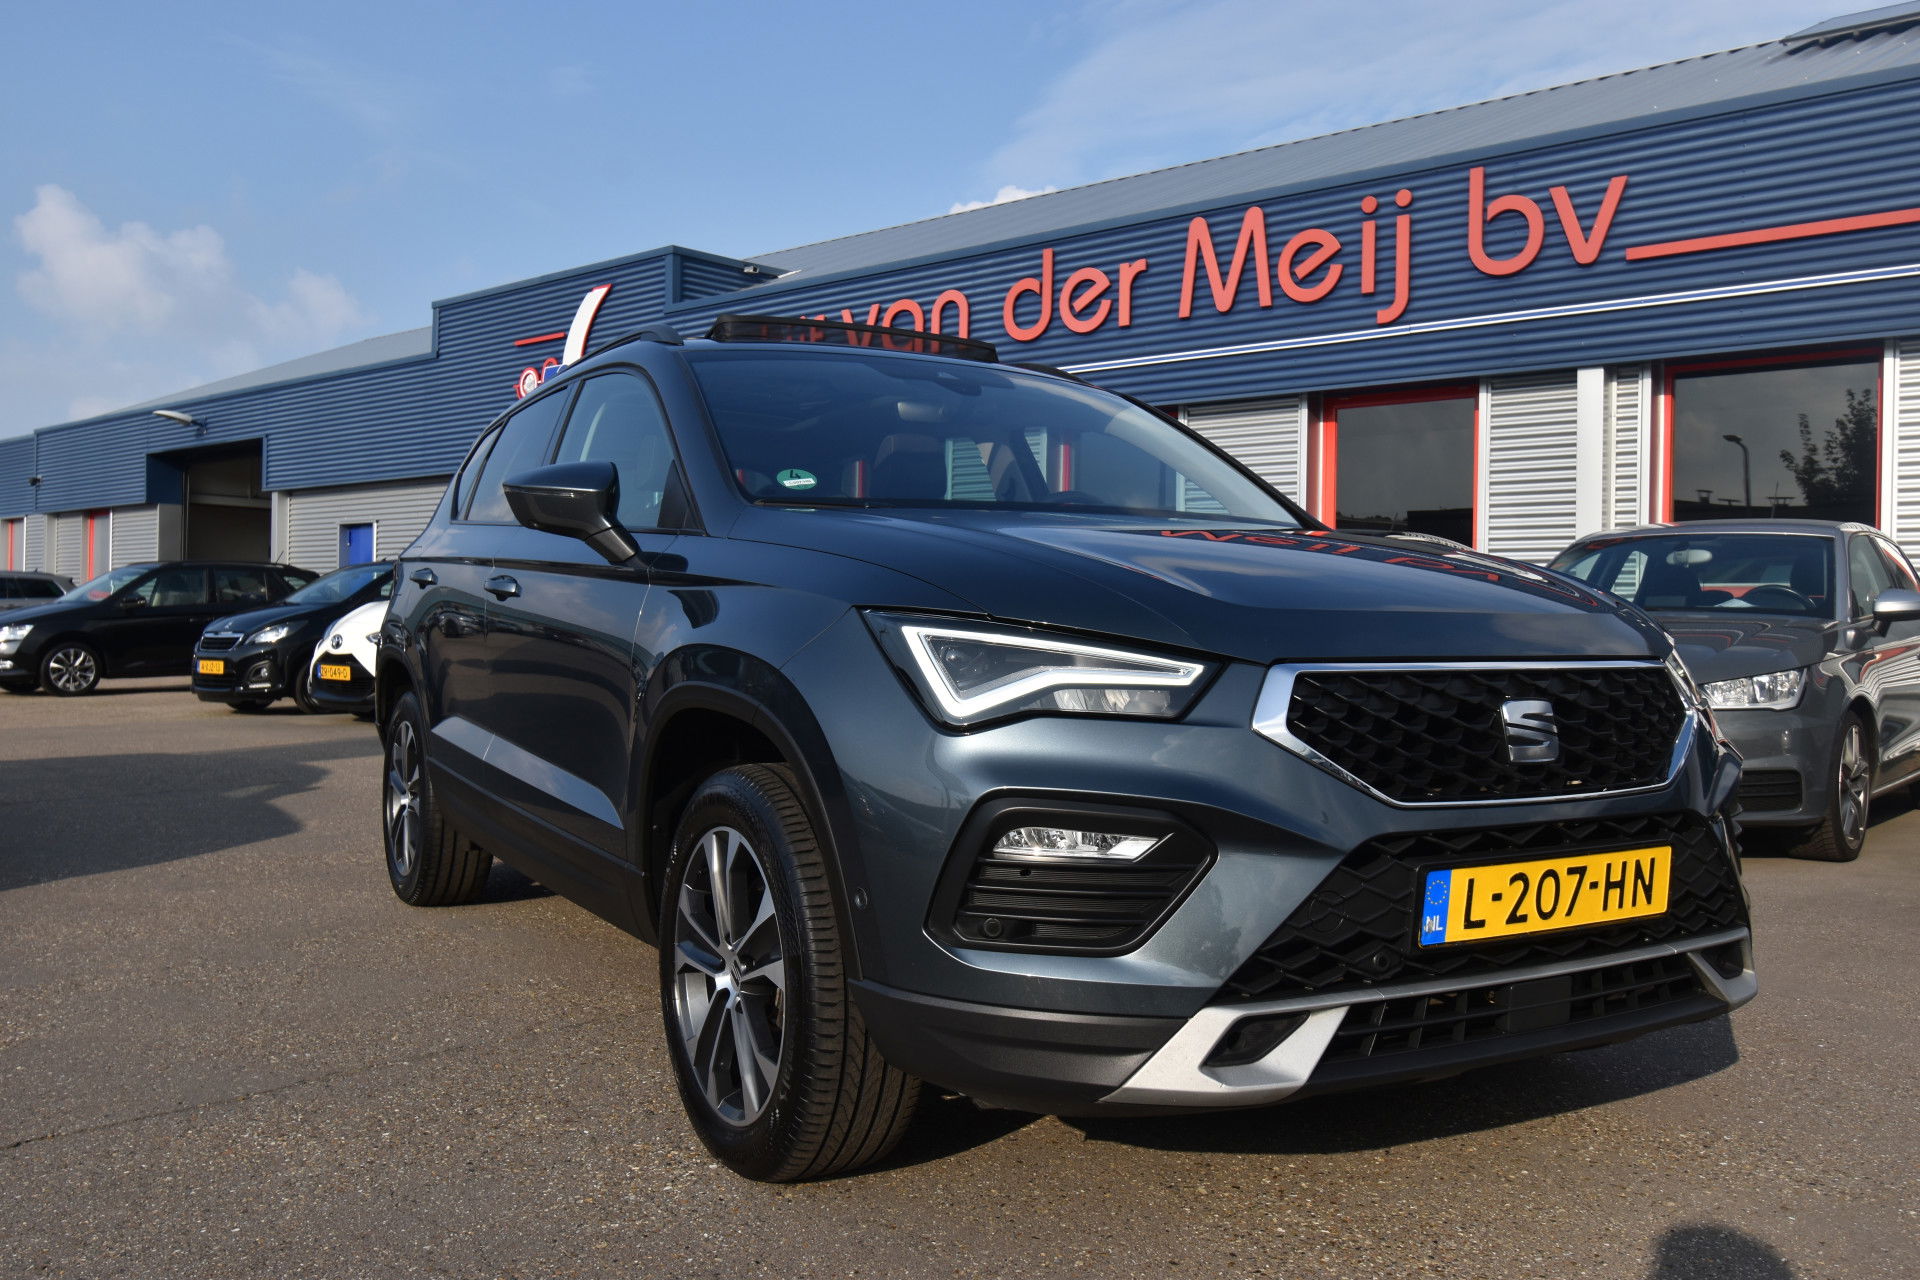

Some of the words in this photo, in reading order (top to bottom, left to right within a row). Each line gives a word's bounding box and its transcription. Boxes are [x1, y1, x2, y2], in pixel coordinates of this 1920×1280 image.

[841, 289, 969, 353] van
[1002, 247, 1147, 342] der
[1178, 188, 1413, 325] Meij
[1468, 166, 1629, 276] bv
[1424, 914, 1444, 933] NL
[1463, 857, 1656, 930] L-207-HN
